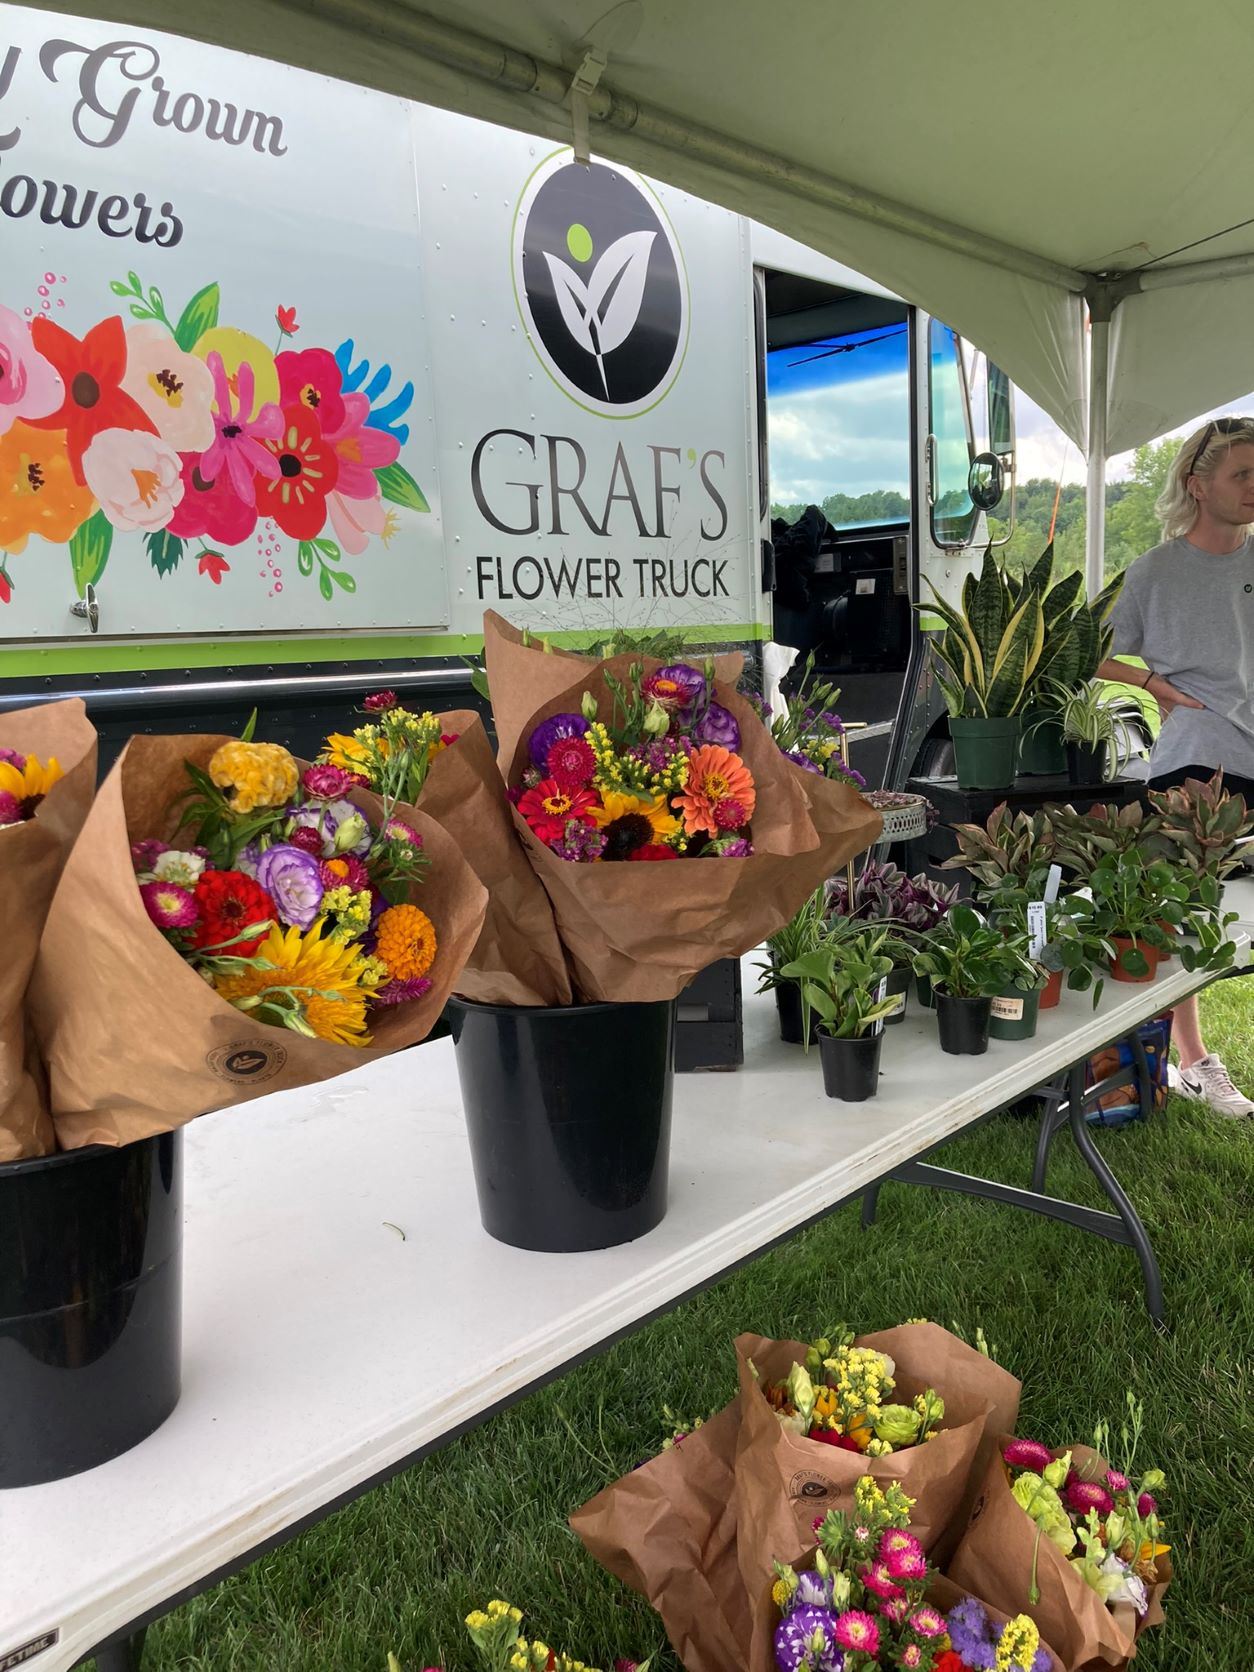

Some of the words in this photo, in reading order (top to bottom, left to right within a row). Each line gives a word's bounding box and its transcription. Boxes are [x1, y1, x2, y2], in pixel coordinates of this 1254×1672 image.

[39, 39, 288, 157] Grown
[0, 174, 184, 248] owers
[470, 428, 728, 542] GRAF'S
[476, 556, 624, 600] FLOWER
[633, 558, 730, 598] TRUCK
